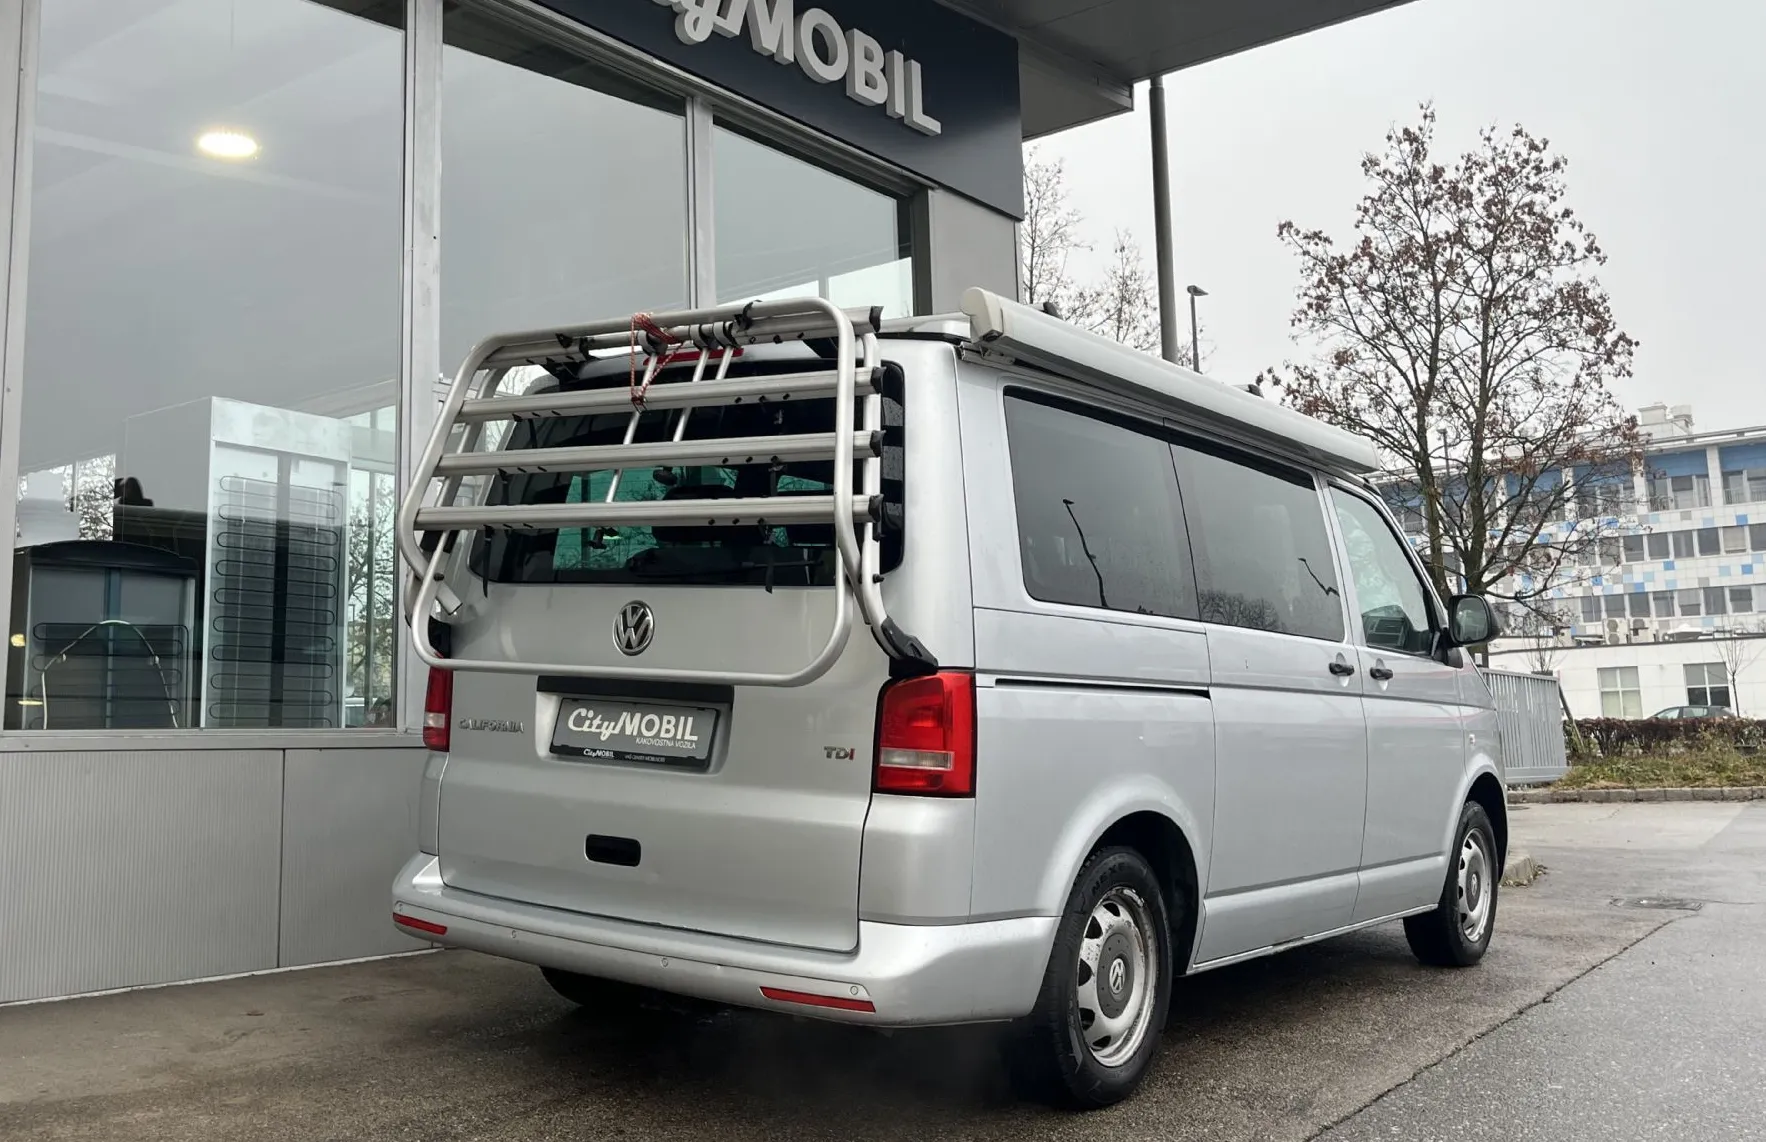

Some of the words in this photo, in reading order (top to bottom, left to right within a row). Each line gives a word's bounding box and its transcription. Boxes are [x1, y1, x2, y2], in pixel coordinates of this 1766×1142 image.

[459, 718, 524, 733] CALIFORNIA
[568, 708, 699, 742] CityMOBIL
[824, 746, 855, 760] TDI
